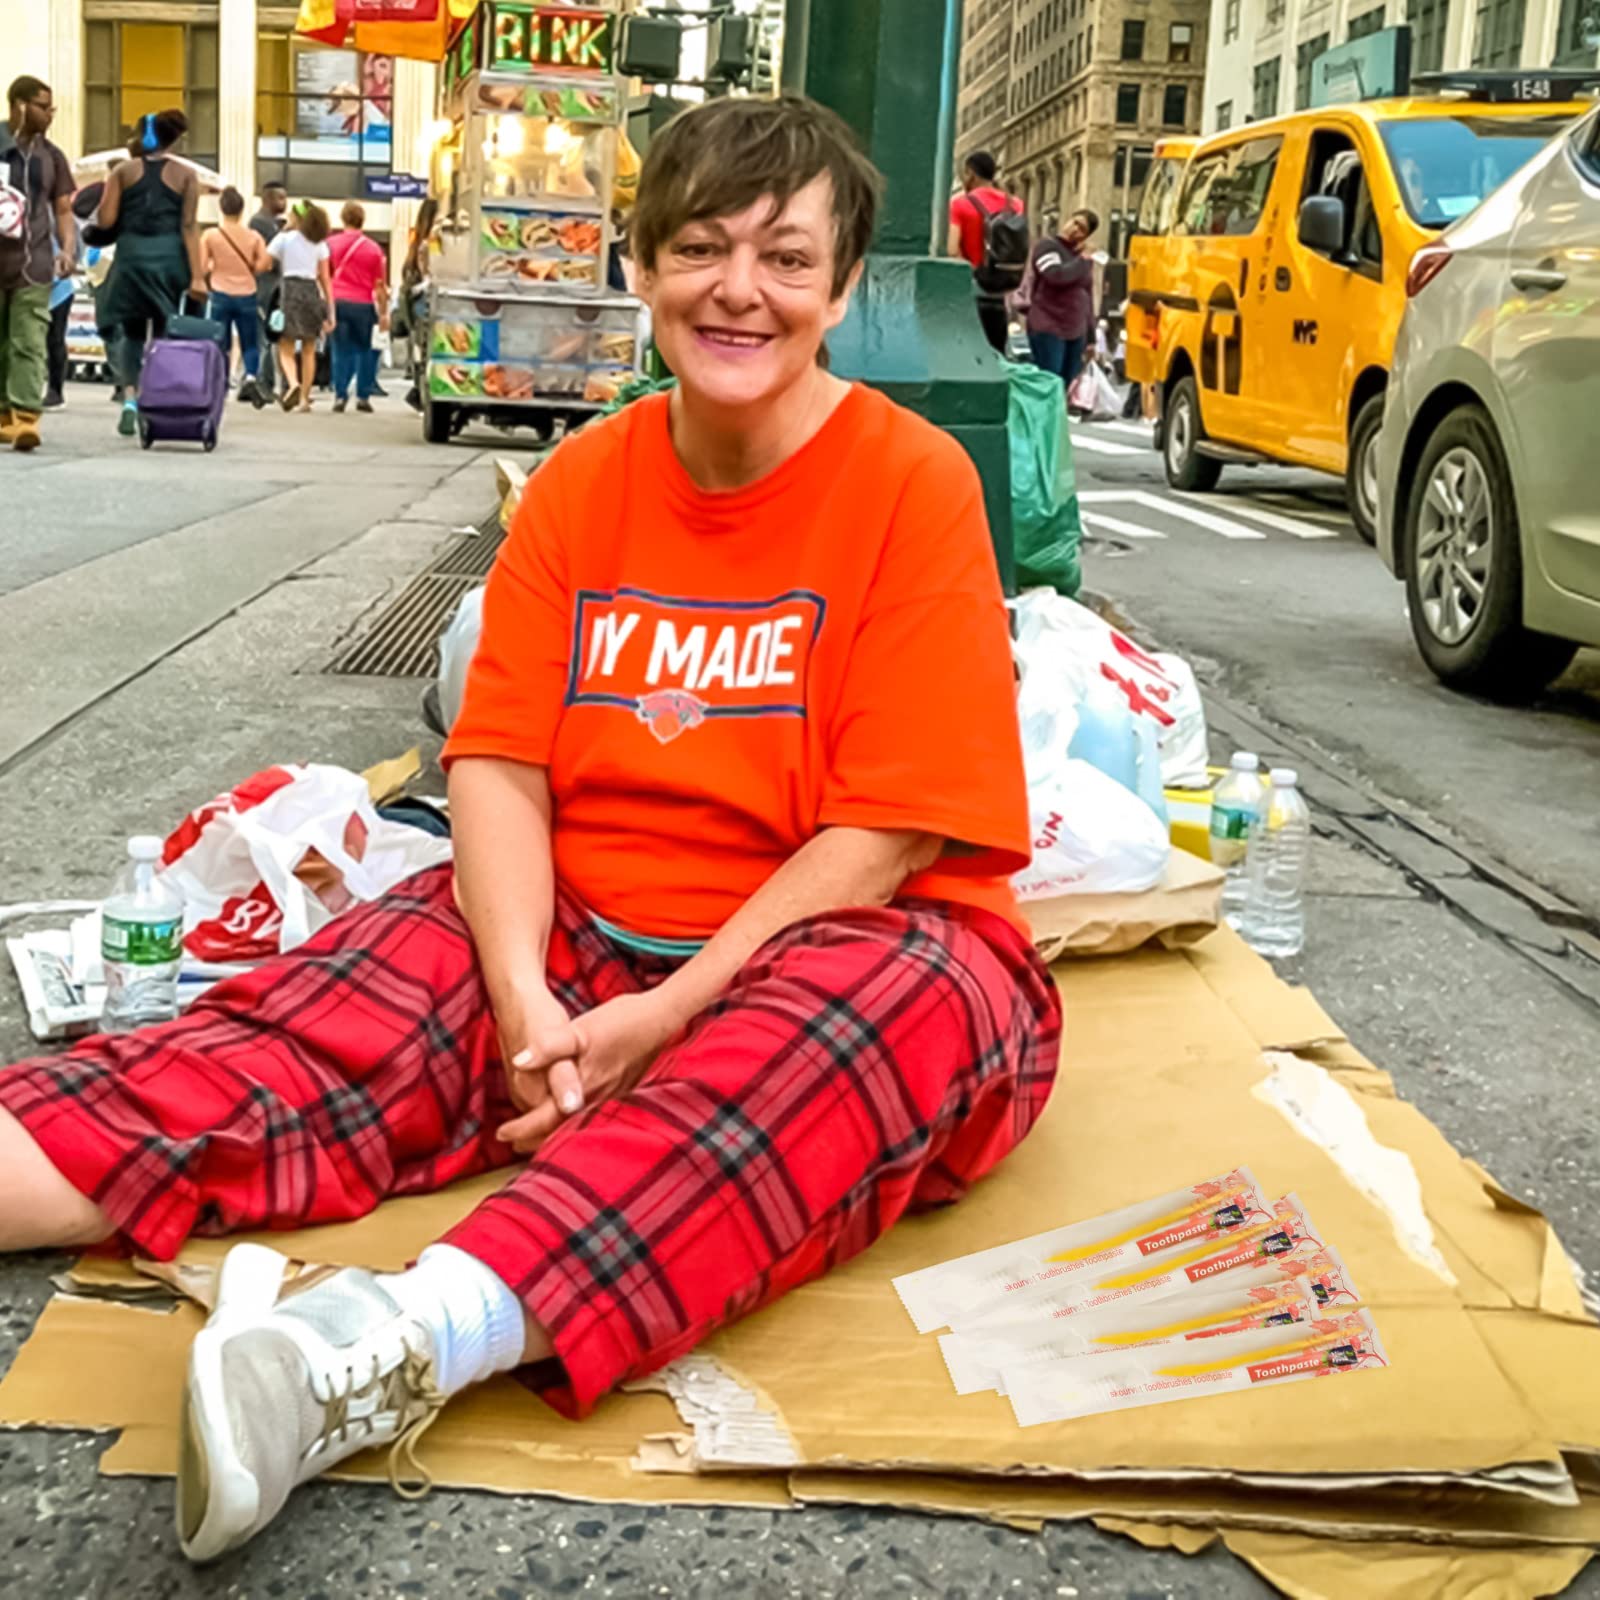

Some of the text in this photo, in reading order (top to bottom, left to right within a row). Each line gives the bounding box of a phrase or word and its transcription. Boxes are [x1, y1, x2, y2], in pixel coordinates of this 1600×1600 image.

[1293, 319, 1318, 345] NYC
[645, 615, 803, 690] MADE
[1144, 1222, 1208, 1252] Toothpaste
[1192, 1249, 1256, 1279] Toothpaste
[1254, 1358, 1320, 1379] Toothpaste
